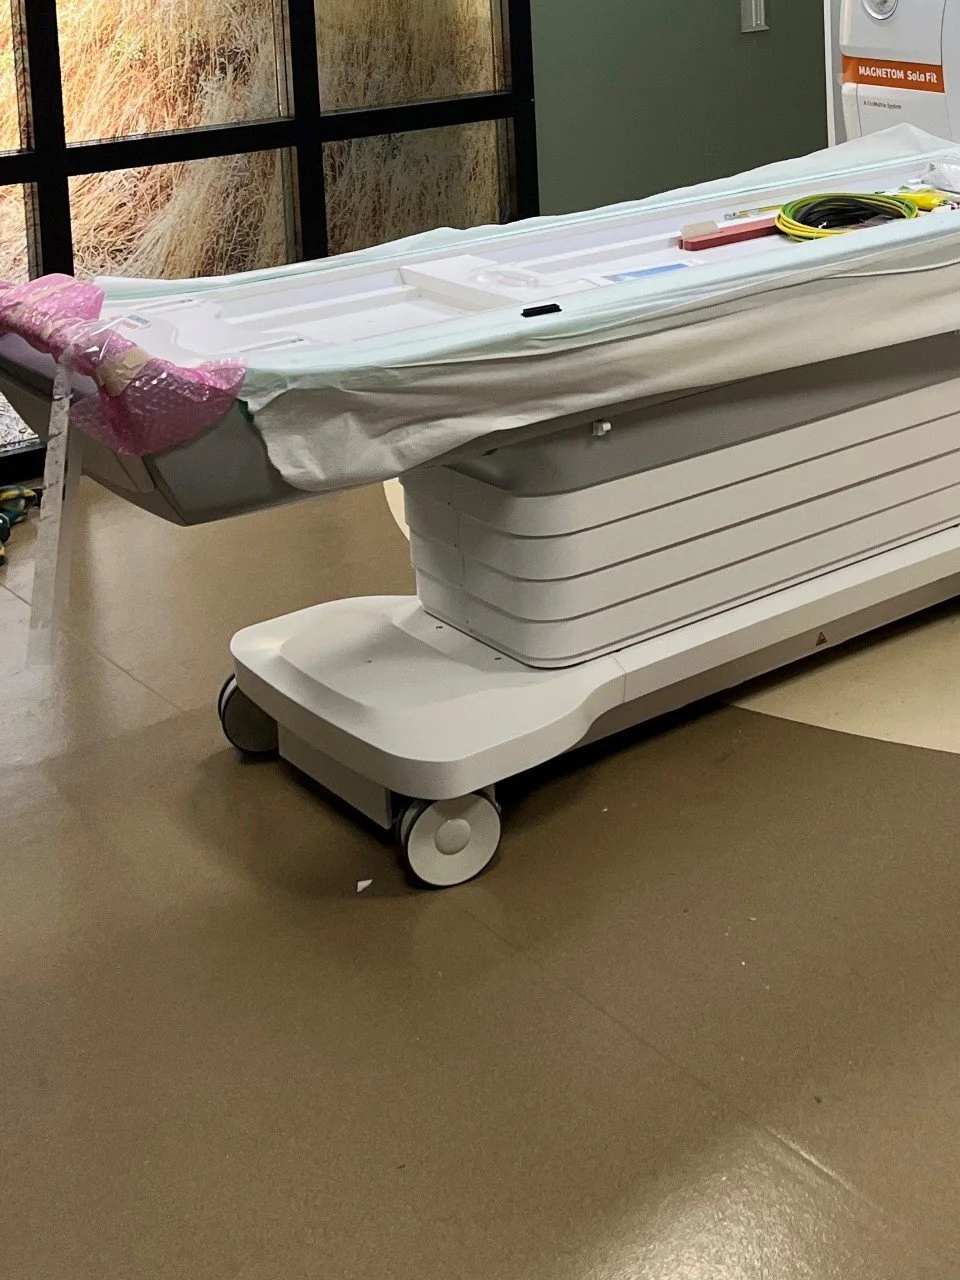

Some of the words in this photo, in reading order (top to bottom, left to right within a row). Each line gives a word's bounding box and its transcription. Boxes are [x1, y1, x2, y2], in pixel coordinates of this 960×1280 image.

[858, 65, 904, 80] MAGNETOM
[907, 70, 925, 82] Sola
[926, 72, 938, 83] Fit
